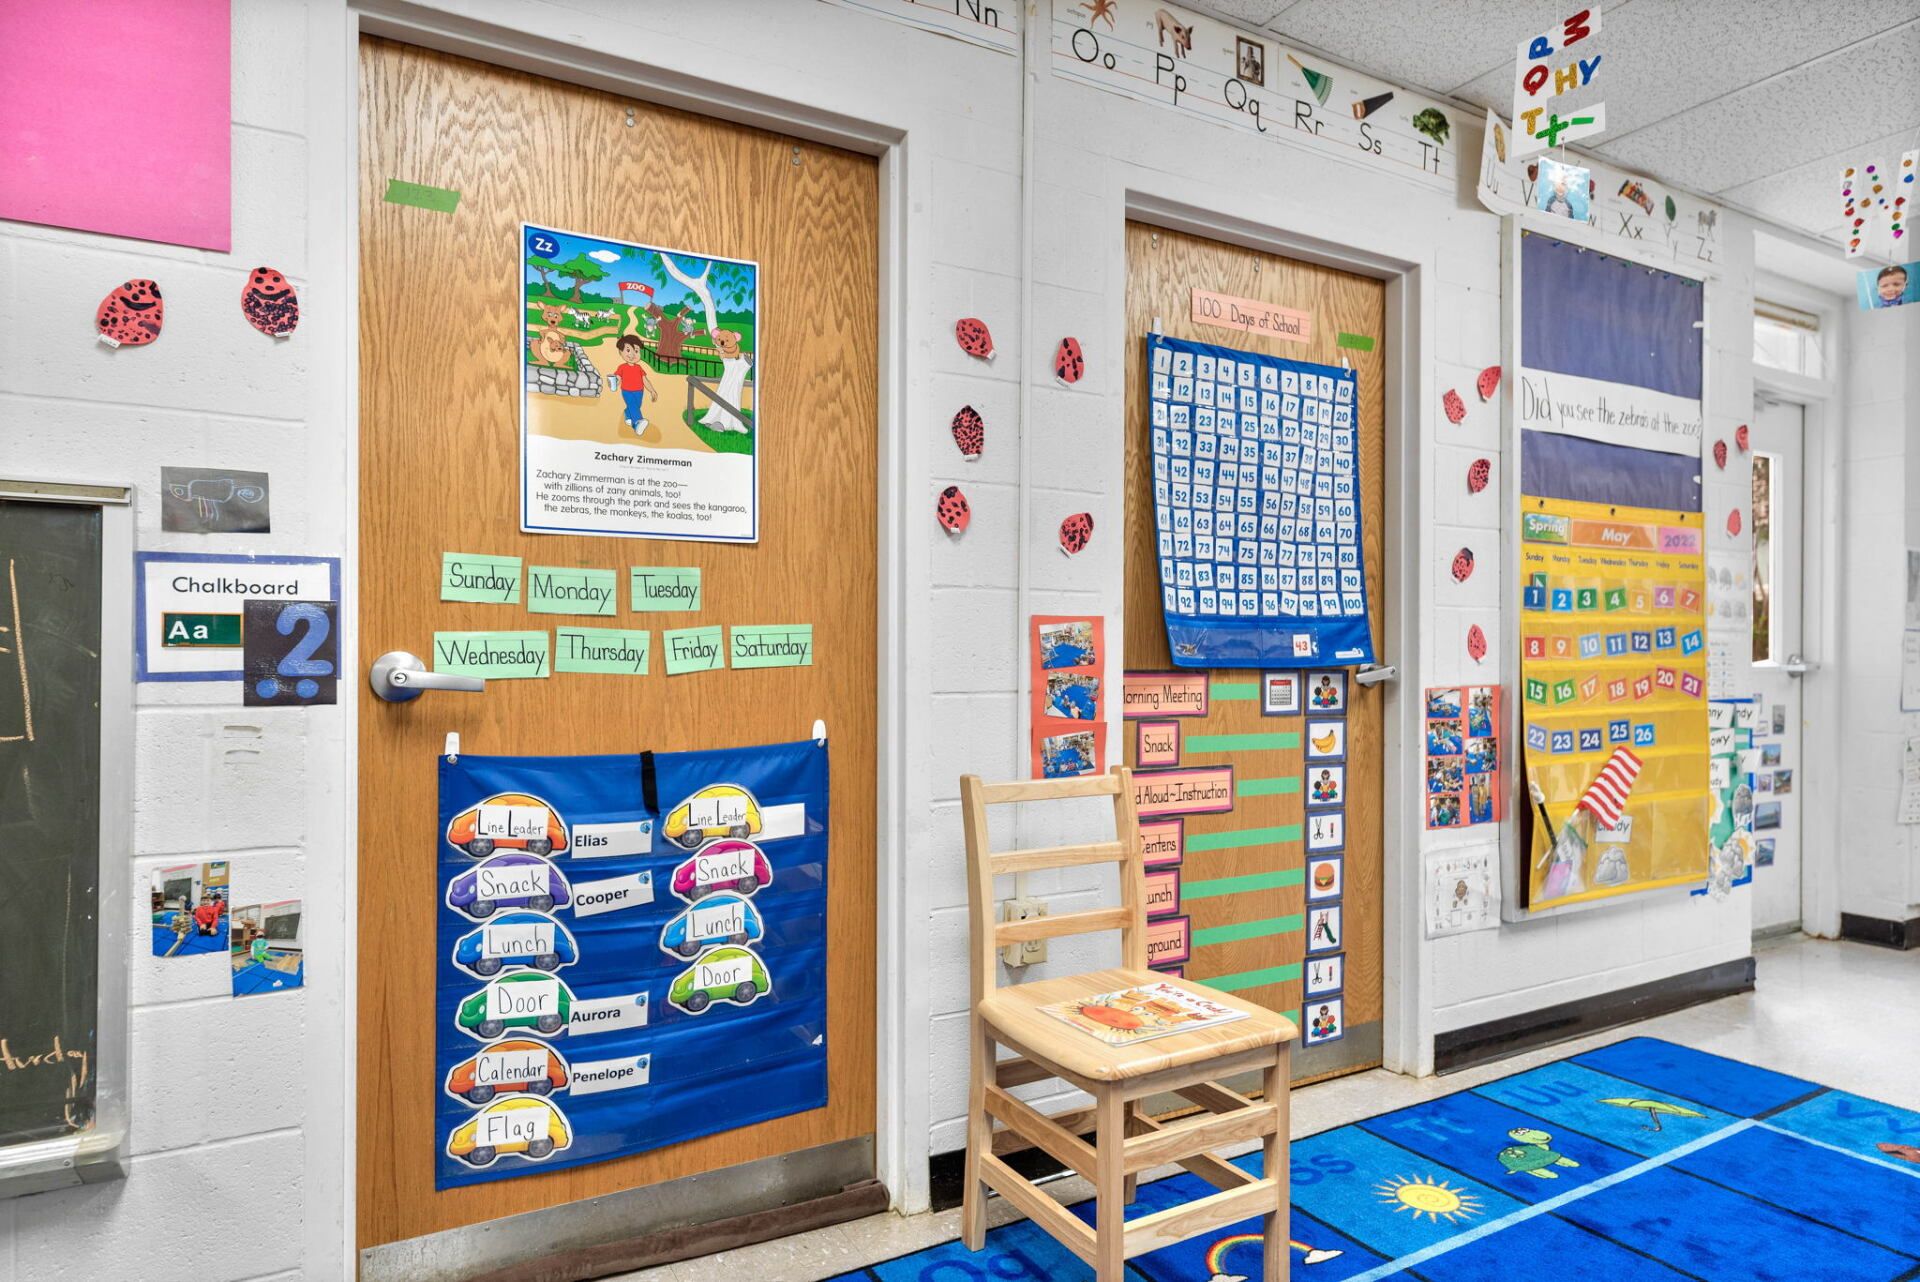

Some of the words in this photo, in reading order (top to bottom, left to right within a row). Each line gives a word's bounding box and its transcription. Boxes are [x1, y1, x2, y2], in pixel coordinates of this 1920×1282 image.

[1071, 28, 1116, 70] Oo
[1156, 52, 1187, 106] Pp
[1224, 78, 1267, 132] Qq
[1295, 99, 1324, 135] Rr
[1358, 122, 1382, 155] Ss
[1417, 140, 1440, 174] Tt
[534, 237, 554, 253] Zz
[1198, 296, 1222, 319] 100
[1231, 306, 1255, 330] Days
[1258, 311, 1271, 328] of
[1272, 312, 1301, 335] School
[1160, 356, 1165, 368] 1
[1179, 359, 1187, 371] 2
[1203, 363, 1210, 374] 3
[1222, 366, 1230, 377] 4
[1243, 369, 1249, 381] 5
[1265, 374, 1272, 385] 6
[1286, 377, 1292, 388] 7
[1305, 380, 1312, 391] 8
[1322, 383, 1328, 394] 9
[1339, 386, 1349, 398] 10
[1521, 376, 1552, 421] Did
[1556, 401, 1575, 428] you
[1576, 403, 1594, 422] see
[1597, 396, 1615, 425] the
[1663, 413, 1679, 433] the
[594, 452, 634, 464] Zachary
[637, 455, 692, 467] Zimmerman
[536, 469, 571, 482] Zachary
[574, 472, 625, 484] Zimmerman
[628, 476, 635, 485] is
[637, 478, 645, 486] at
[647, 478, 660, 487] the
[536, 491, 549, 501] He
[551, 494, 580, 503] zooms
[582, 495, 615, 507] through
[617, 498, 630, 506] the
[633, 499, 652, 508] park
[654, 501, 670, 509] and
[693, 501, 706, 510] the
[708, 502, 747, 514] kangaroo,
[544, 482, 563, 491] with
[565, 483, 593, 493] zillions
[595, 485, 604, 494] of
[607, 487, 626, 496] zany
[629, 488, 663, 499] animals,
[665, 490, 681, 499] too!
[544, 503, 558, 512] the
[560, 505, 592, 515] zebras,
[594, 506, 607, 515] the
[609, 509, 649, 519] monkeys,
[651, 510, 664, 519] the
[666, 511, 694, 521] koalas,
[697, 513, 712, 521] too!
[1529, 519, 1565, 536] Spring
[1601, 528, 1632, 545] May
[1525, 552, 1544, 562] Sunday
[172, 576, 299, 595] Chalkboard
[449, 562, 516, 601] Sunday
[533, 573, 612, 613] Monday
[633, 573, 698, 609] Tuesday
[1283, 597, 1295, 610] 97
[1302, 599, 1315, 611] 98
[1324, 599, 1336, 610] 99
[1344, 599, 1361, 611] 100
[1532, 590, 1539, 604] 1
[1558, 593, 1567, 607] 2
[1582, 591, 1591, 605] 3
[1610, 592, 1620, 606] 4
[1636, 595, 1644, 608] 5
[1660, 591, 1669, 604] 6
[1685, 593, 1695, 605] 7
[168, 620, 209, 639] Aa
[275, 603, 334, 677] 2
[437, 640, 546, 675] Wednesday
[560, 634, 645, 672] Thursday
[672, 636, 719, 668] Friday
[735, 634, 808, 664] Saturday
[1295, 640, 1308, 651] 43
[1530, 641, 1539, 655] 8
[1557, 640, 1566, 654] 9
[1582, 639, 1598, 652] 10
[1610, 638, 1622, 651] 11
[1634, 636, 1648, 649] 12
[1658, 631, 1672, 645] 13
[1684, 636, 1699, 651] 14
[1529, 683, 1543, 699] 15
[1556, 684, 1571, 698] 16
[1582, 679, 1596, 696] 17
[1610, 682, 1624, 696] 18
[1635, 680, 1649, 694] 19
[1657, 671, 1674, 685] 20
[1684, 679, 1698, 693] 21
[1123, 685, 1160, 710] orning
[1162, 684, 1203, 711] Meeting
[1144, 734, 1173, 753] Snack
[1529, 729, 1545, 746] 22
[1554, 735, 1571, 749] 23
[1581, 733, 1600, 747] 24
[1611, 725, 1628, 738] 25
[1636, 728, 1652, 742] 26
[477, 808, 505, 837] Line
[507, 808, 544, 838] Leader
[689, 804, 713, 827] Line
[715, 800, 746, 825] Leader
[574, 834, 608, 848] Elias
[697, 857, 748, 882] Snack
[481, 869, 546, 896] Snack
[1146, 883, 1173, 905] unch
[575, 888, 630, 908] Cooper
[691, 907, 743, 938] Lunch
[487, 931, 547, 956] Lunch
[702, 964, 741, 987] Door
[498, 987, 549, 1015] Door
[571, 1006, 621, 1023] Aurora
[478, 1056, 546, 1082] Calendar
[572, 1066, 634, 1085] Penelope
[487, 1115, 535, 1141] Flag
